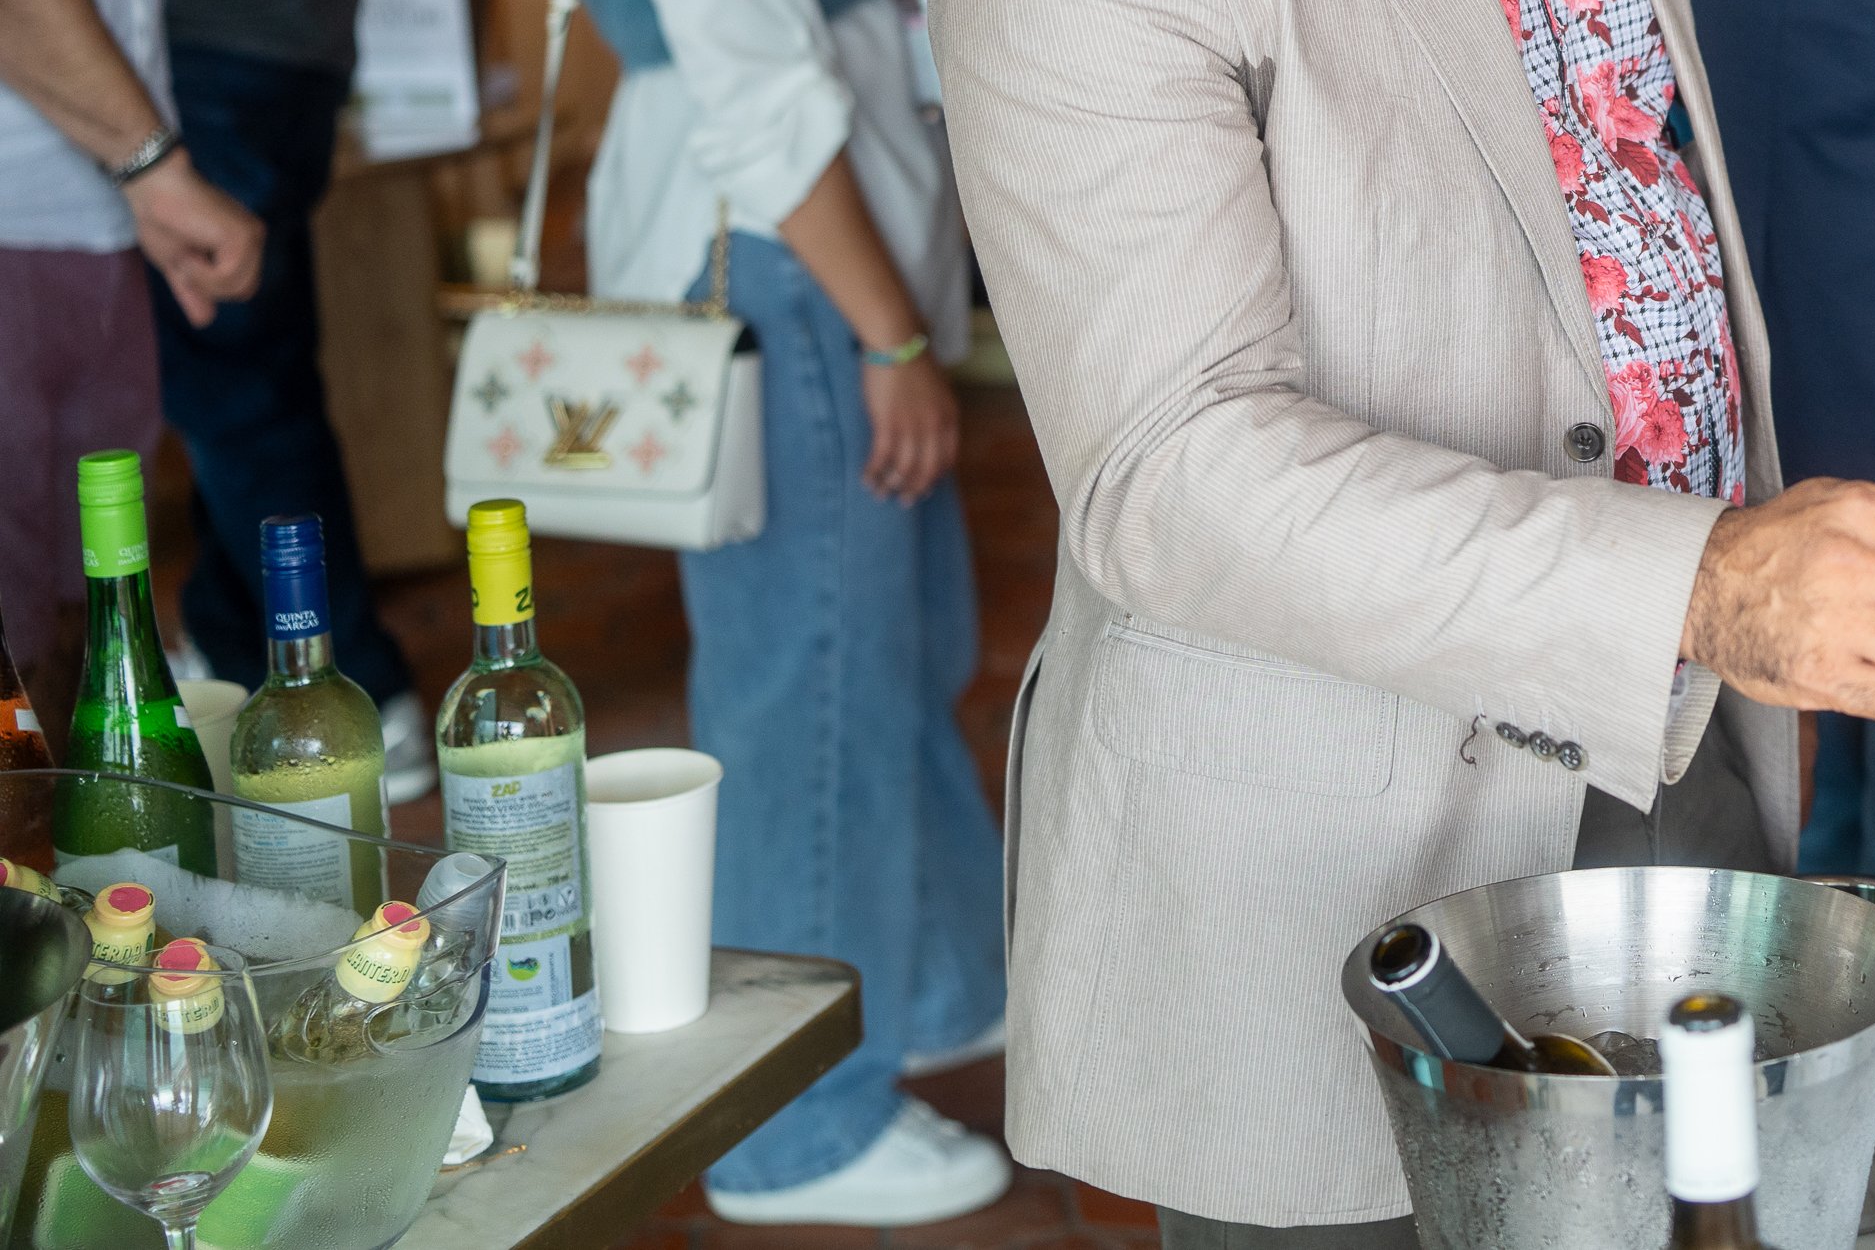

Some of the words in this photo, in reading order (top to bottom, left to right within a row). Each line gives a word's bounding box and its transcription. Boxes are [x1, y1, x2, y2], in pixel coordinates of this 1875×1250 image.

[275, 610, 317, 624] QUINTA
[287, 617, 320, 631] ARCAS
[491, 780, 522, 798] ZAP
[92, 940, 142, 964] TERNA
